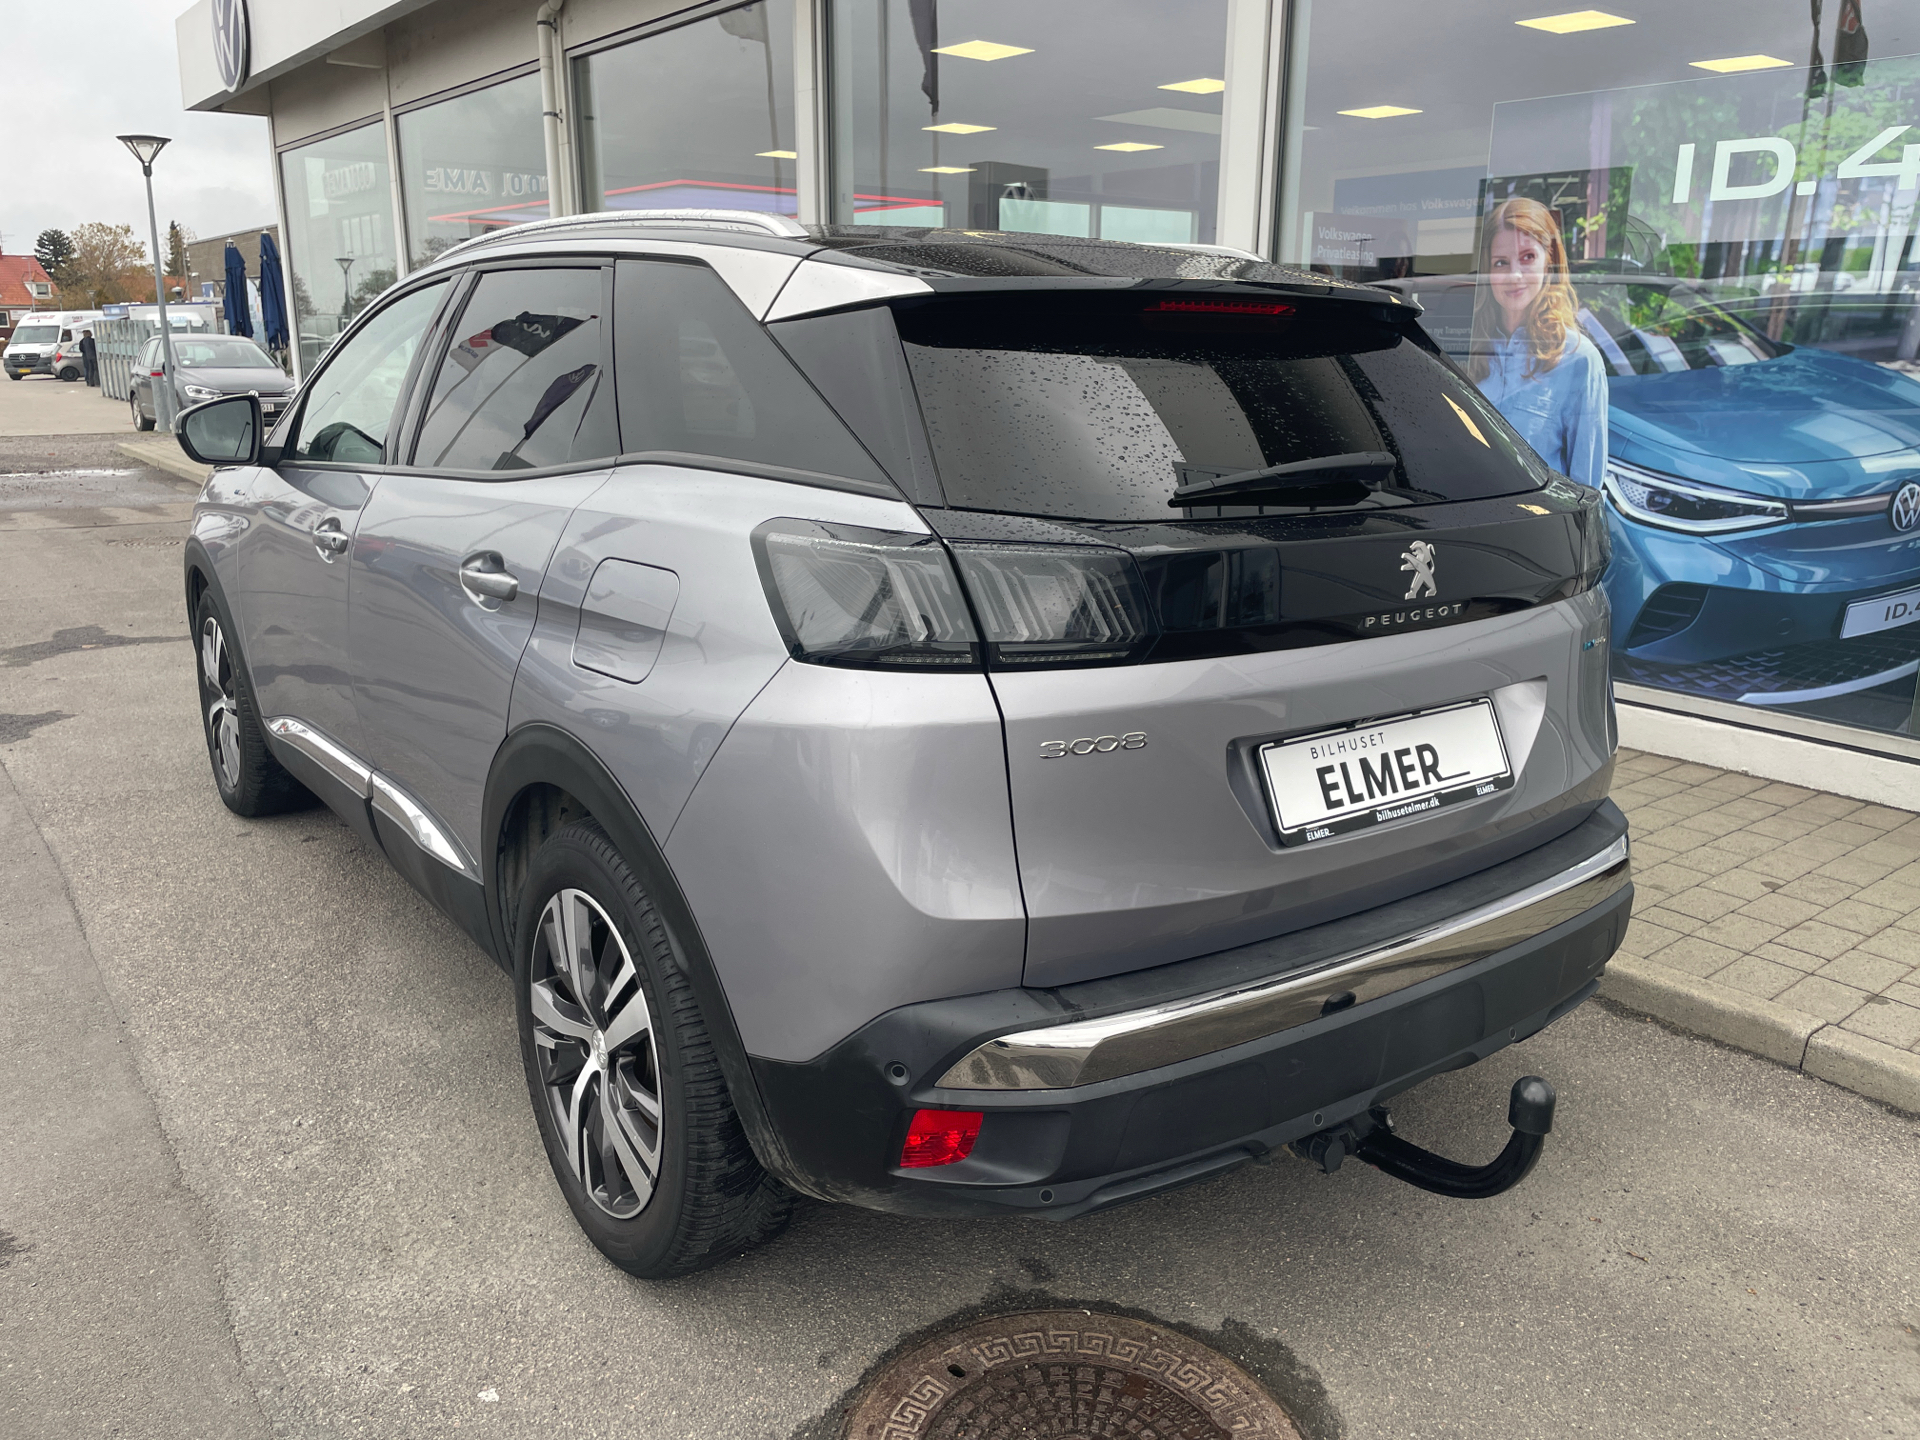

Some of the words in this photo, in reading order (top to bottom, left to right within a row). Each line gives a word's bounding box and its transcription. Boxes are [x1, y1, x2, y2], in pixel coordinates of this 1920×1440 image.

[1672, 124, 1920, 204] ID.4
[1340, 203, 1397, 216] Velkommen
[1399, 201, 1417, 211] hos
[1317, 226, 1373, 246] Volkswagen
[1316, 245, 1375, 264] Privatleasing
[1364, 603, 1462, 628] PEUGEOT
[1039, 731, 1148, 759] 3008
[1310, 732, 1385, 759] BILHUSET
[1315, 743, 1447, 811] ELMER
[1476, 783, 1496, 796] ELMER
[1376, 796, 1440, 822] bilhusetelmer.dk
[1306, 828, 1331, 842] ELMER
